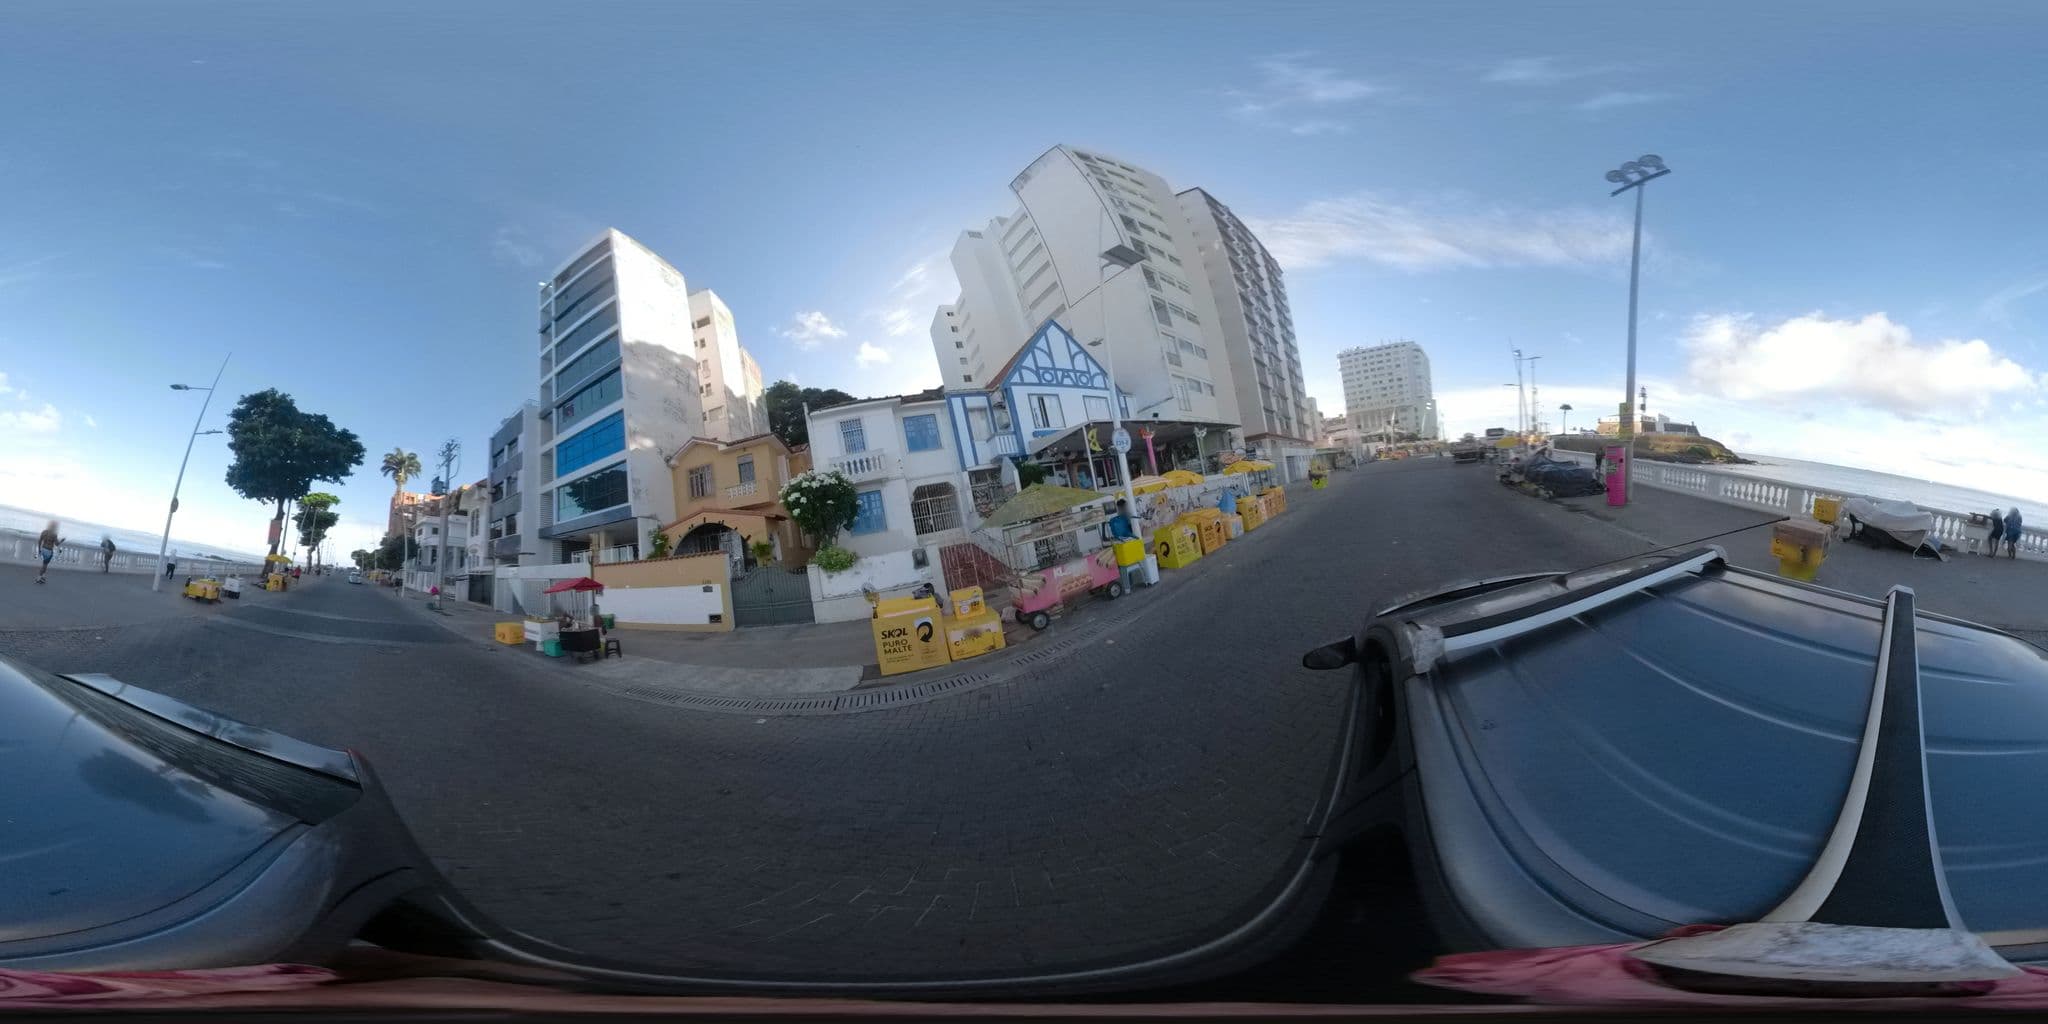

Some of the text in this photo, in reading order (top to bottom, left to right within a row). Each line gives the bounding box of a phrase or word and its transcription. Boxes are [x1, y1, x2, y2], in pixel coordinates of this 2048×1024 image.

[881, 627, 909, 640] SKOL
[882, 638, 909, 649] PURO
[884, 644, 913, 655] MALTE
